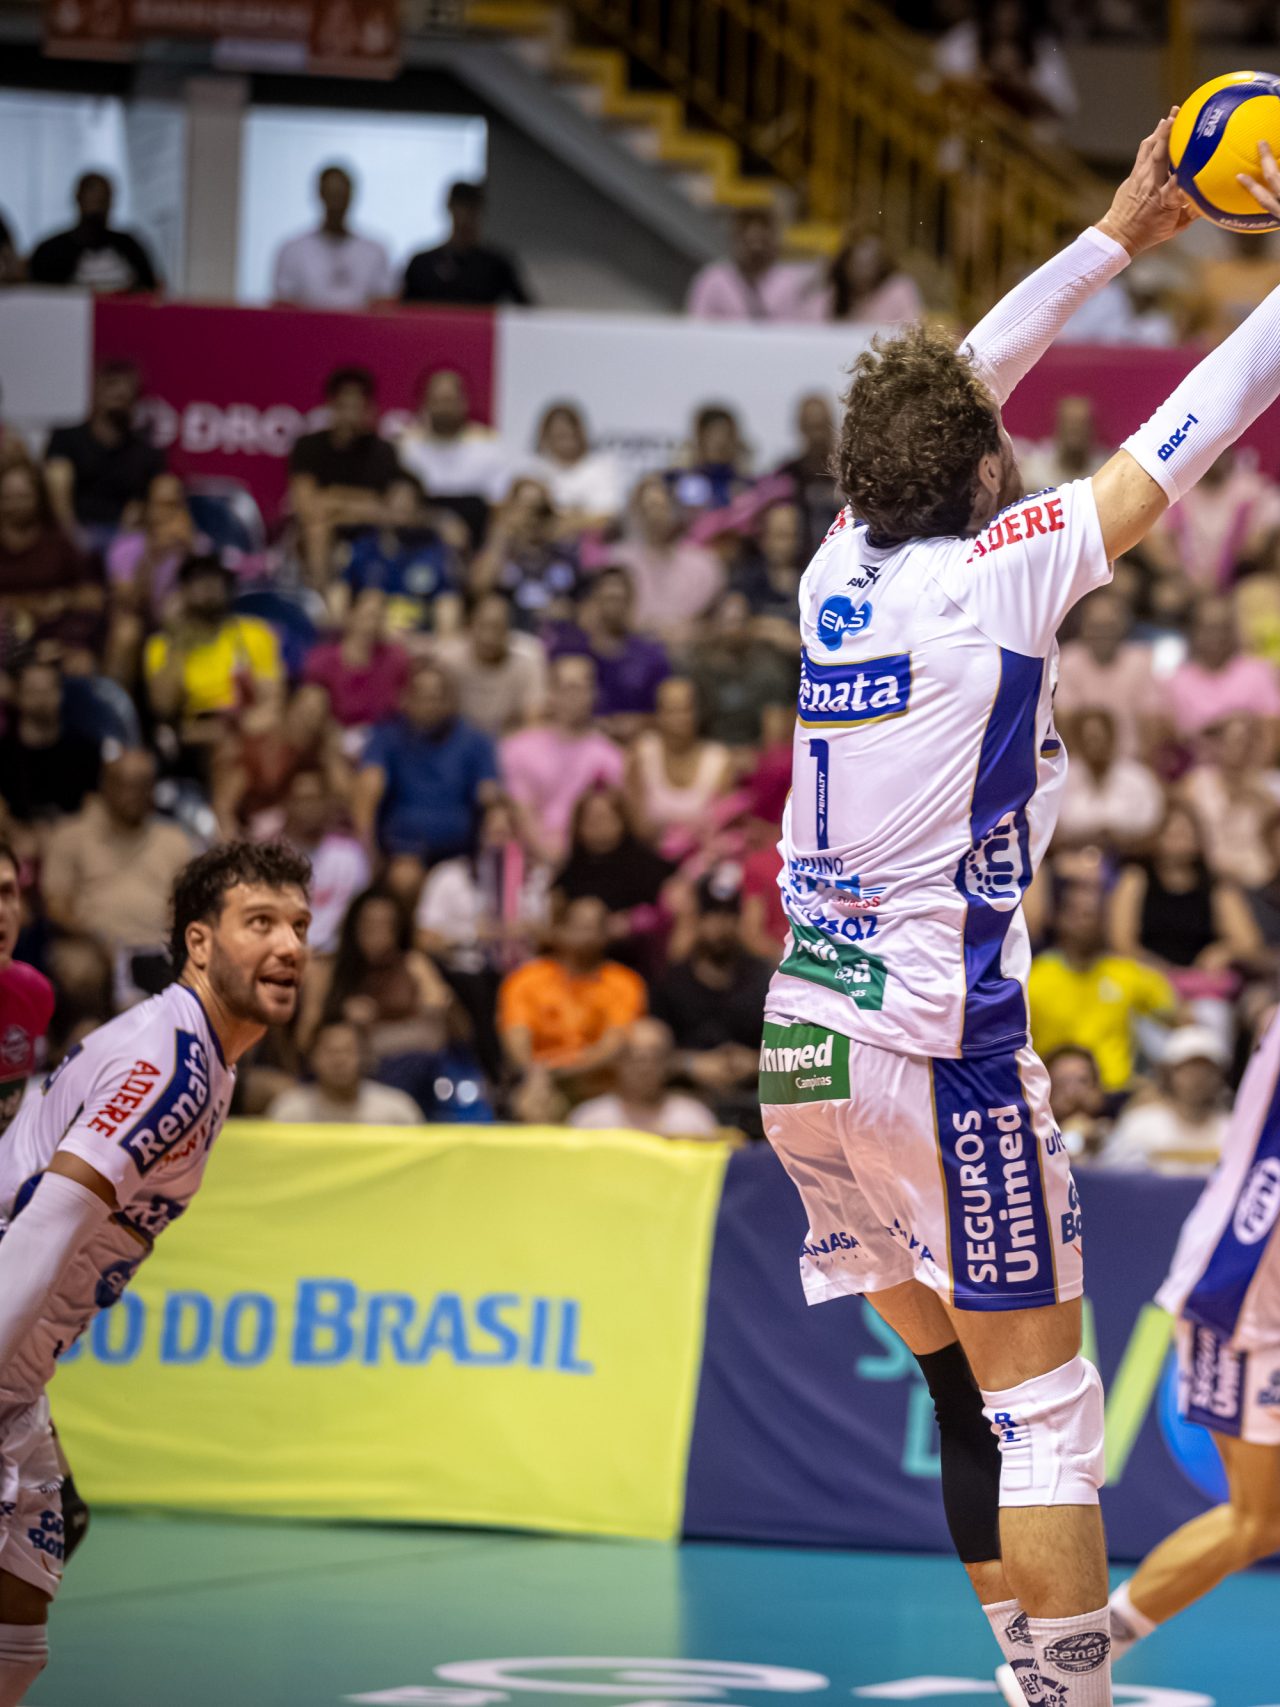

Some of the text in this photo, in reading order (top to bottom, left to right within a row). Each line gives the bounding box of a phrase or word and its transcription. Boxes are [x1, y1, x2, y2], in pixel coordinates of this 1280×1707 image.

[808, 738, 829, 851] 1
[818, 770, 827, 815] PENALTY
[87, 1059, 161, 1138] ADERE
[795, 1076, 833, 1091] Campinas
[952, 1110, 999, 1283] SEGUROS
[987, 1104, 1040, 1283] Unimed
[160, 1289, 277, 1366] DO
[291, 1278, 594, 1375] BRASIL
